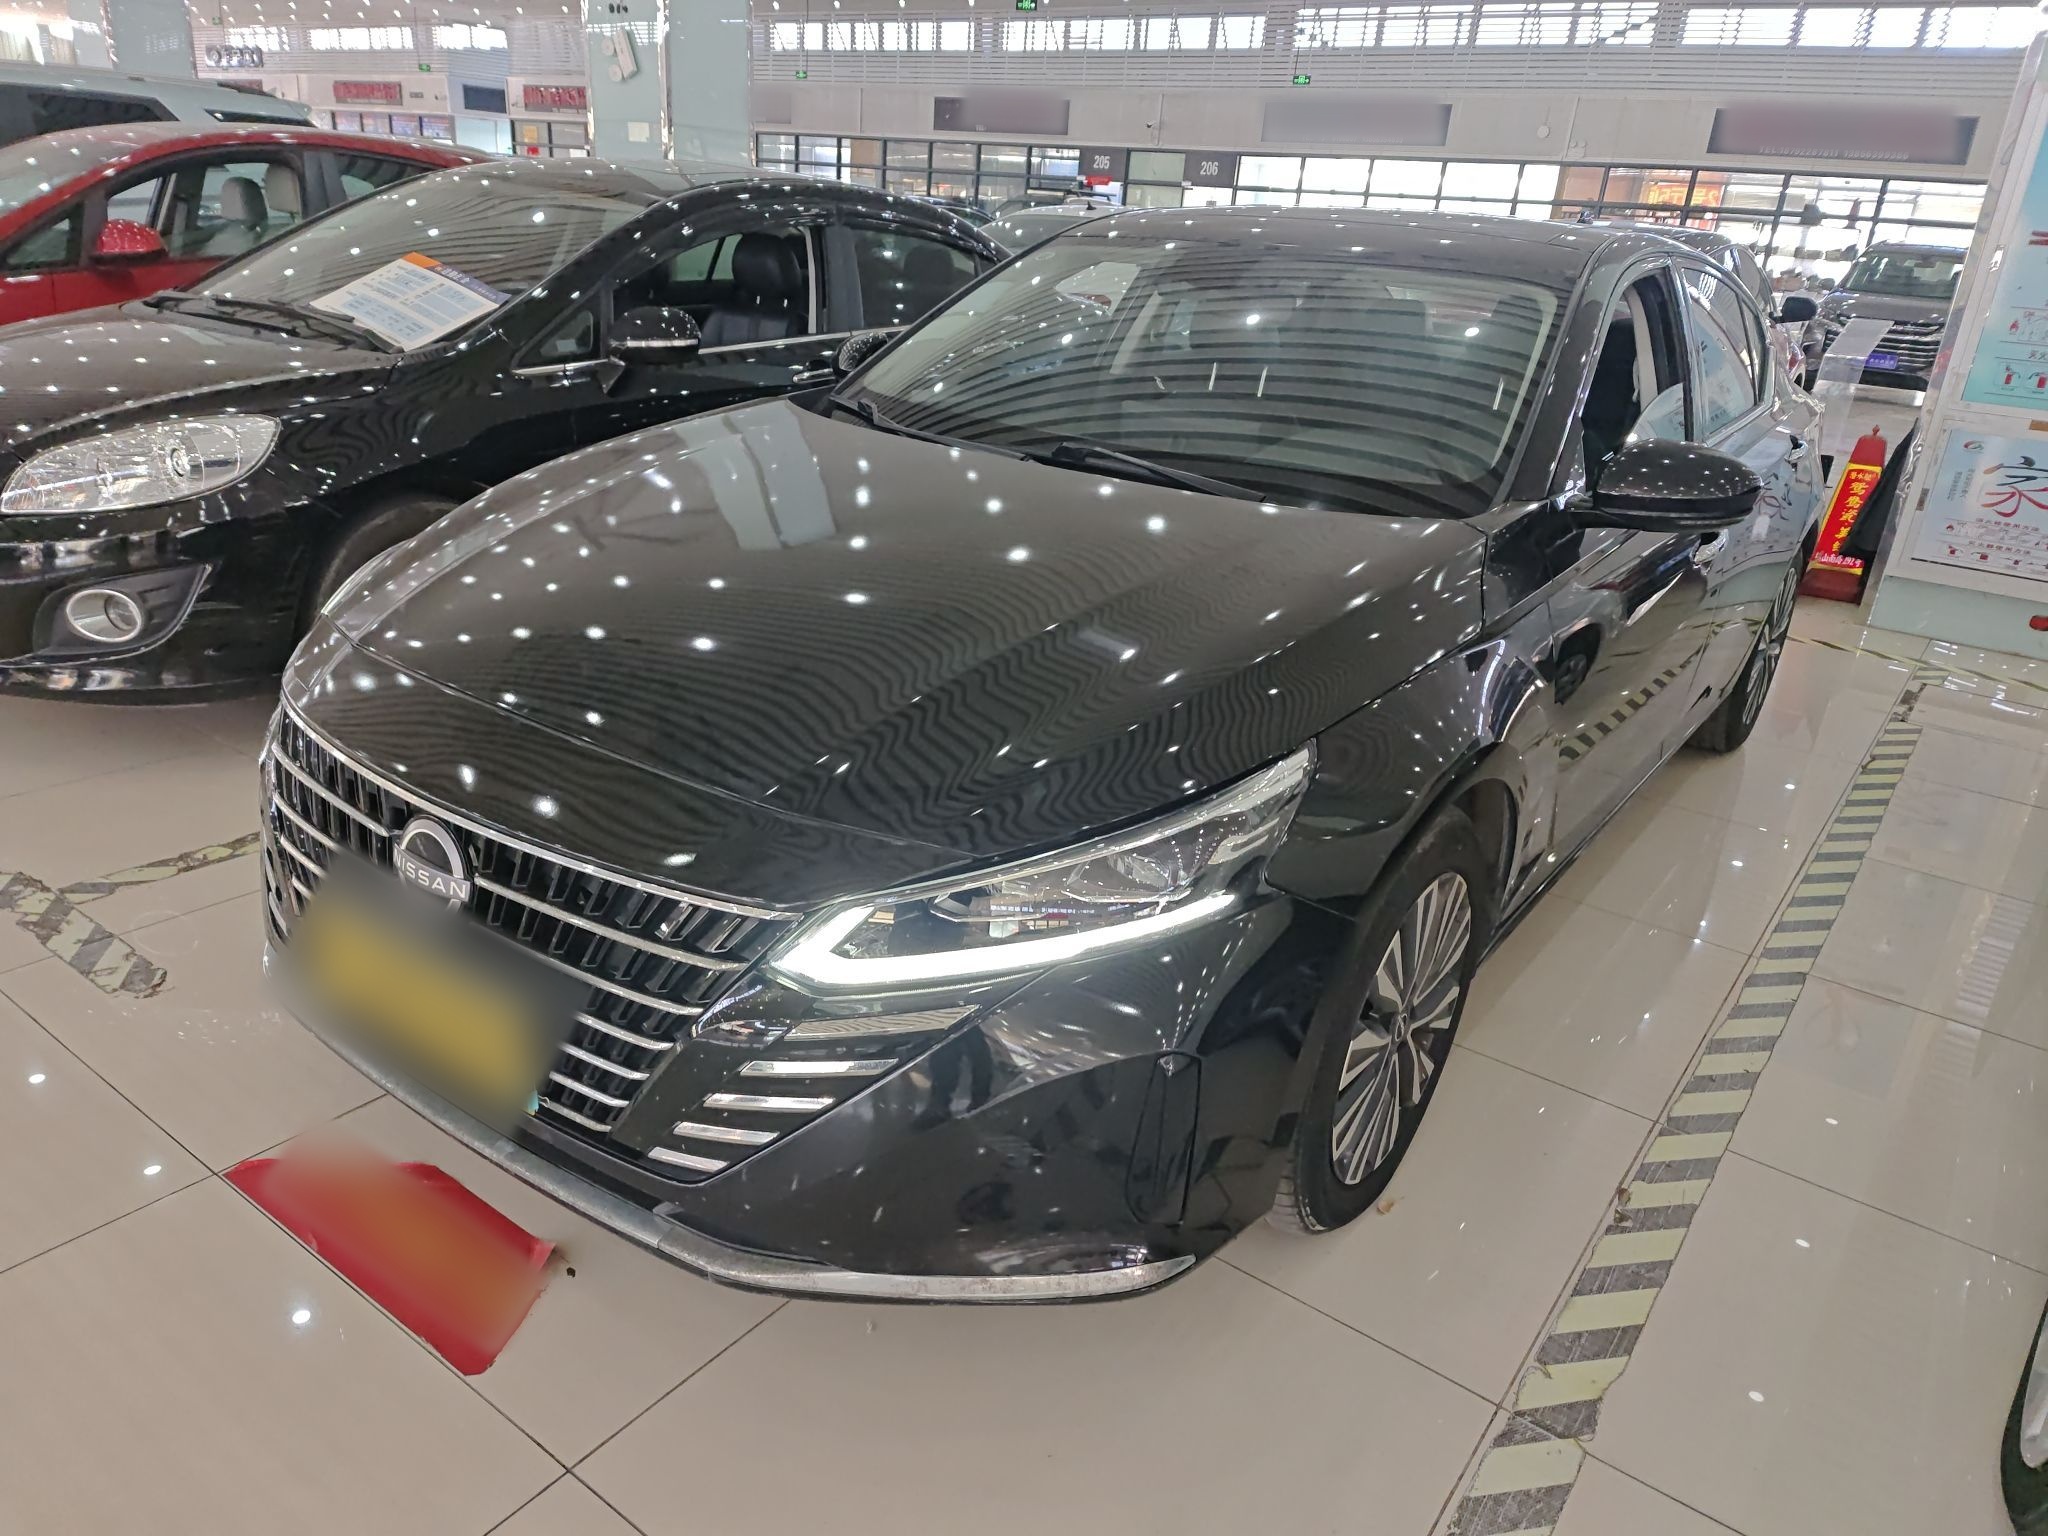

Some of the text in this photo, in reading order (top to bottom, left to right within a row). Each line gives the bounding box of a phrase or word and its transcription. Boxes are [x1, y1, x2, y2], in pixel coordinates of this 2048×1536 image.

[1093, 155, 1110, 169] 205
[1200, 161, 1219, 175] 206
[394, 848, 466, 899] NISSAN
